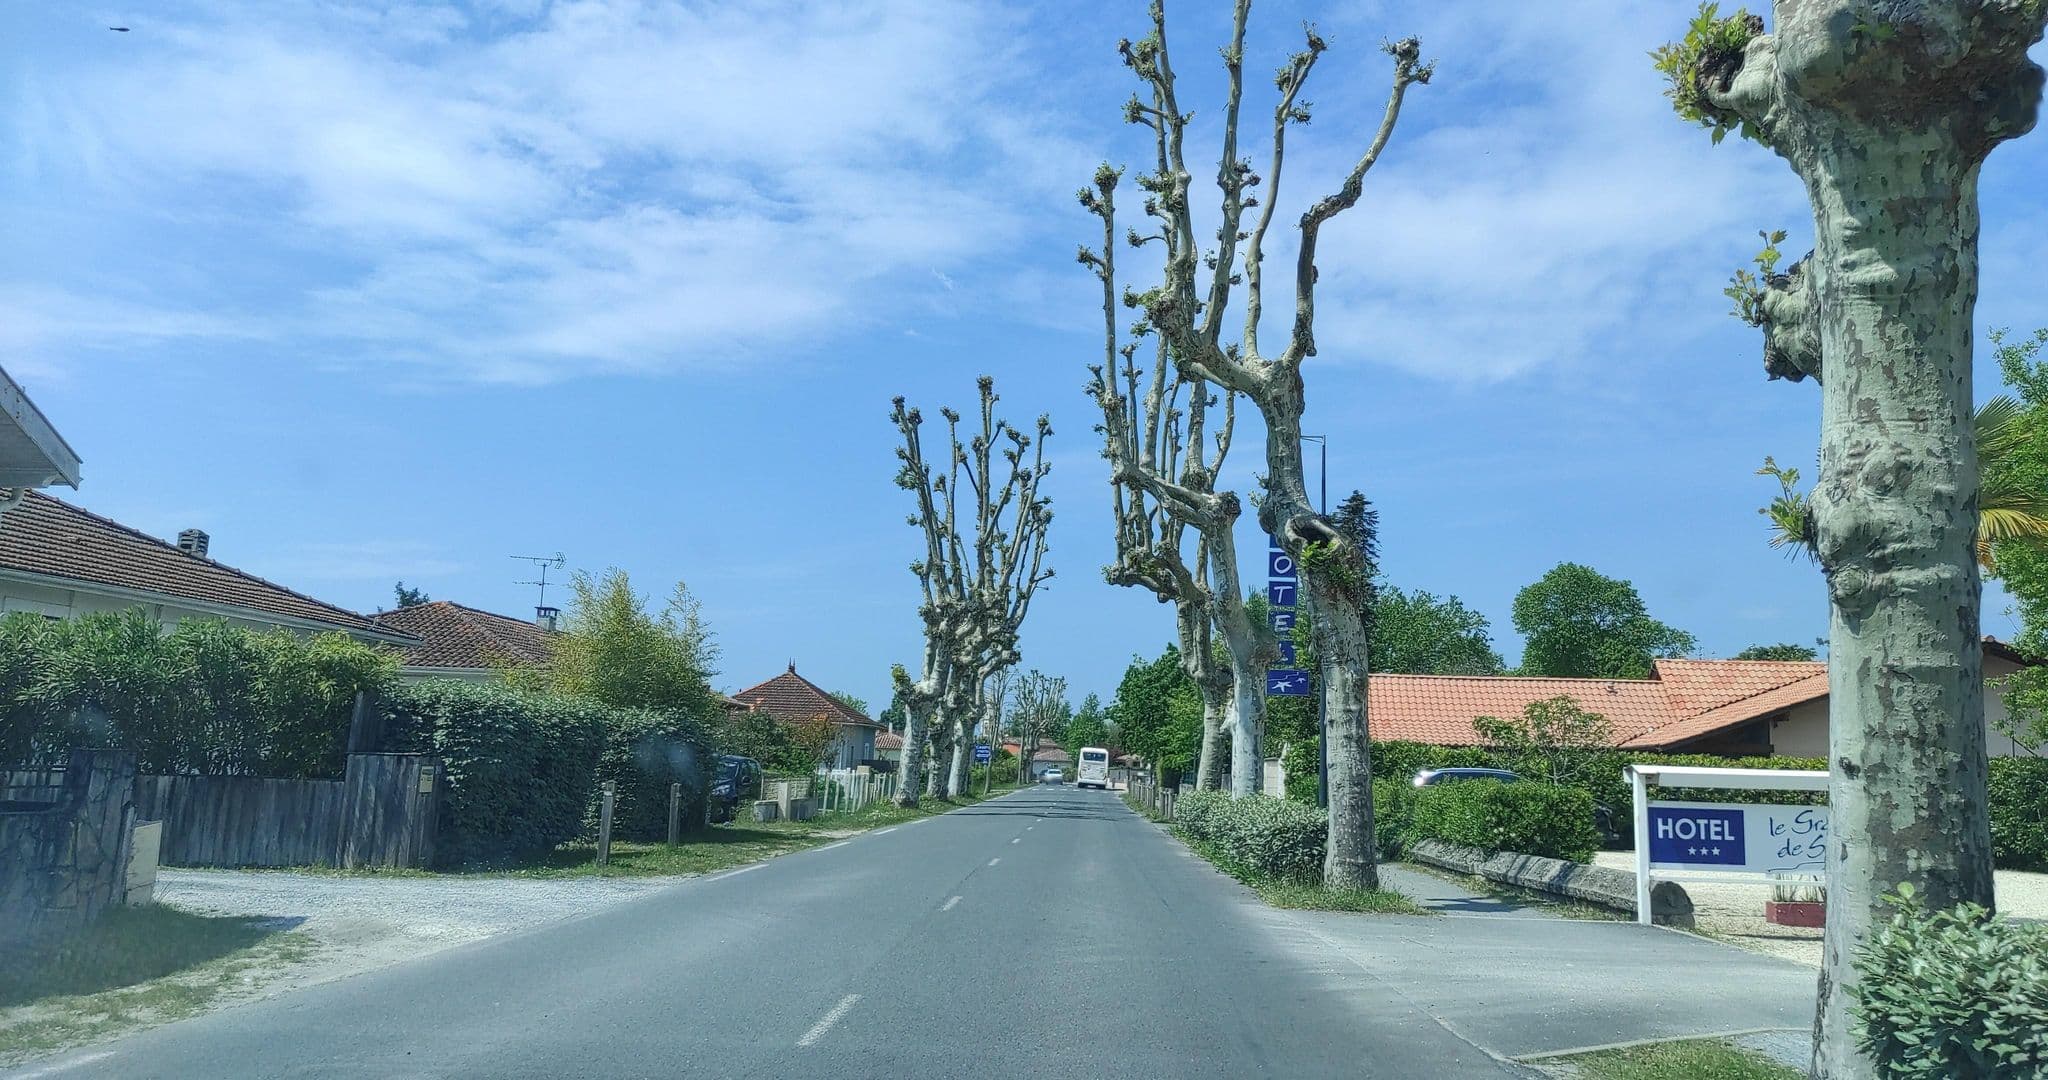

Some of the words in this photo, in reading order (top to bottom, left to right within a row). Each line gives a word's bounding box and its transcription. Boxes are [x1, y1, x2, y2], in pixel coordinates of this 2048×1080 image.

[1657, 817, 1735, 841] HOTEL
[1769, 816, 1786, 837] le
[1777, 838, 1803, 858] de
